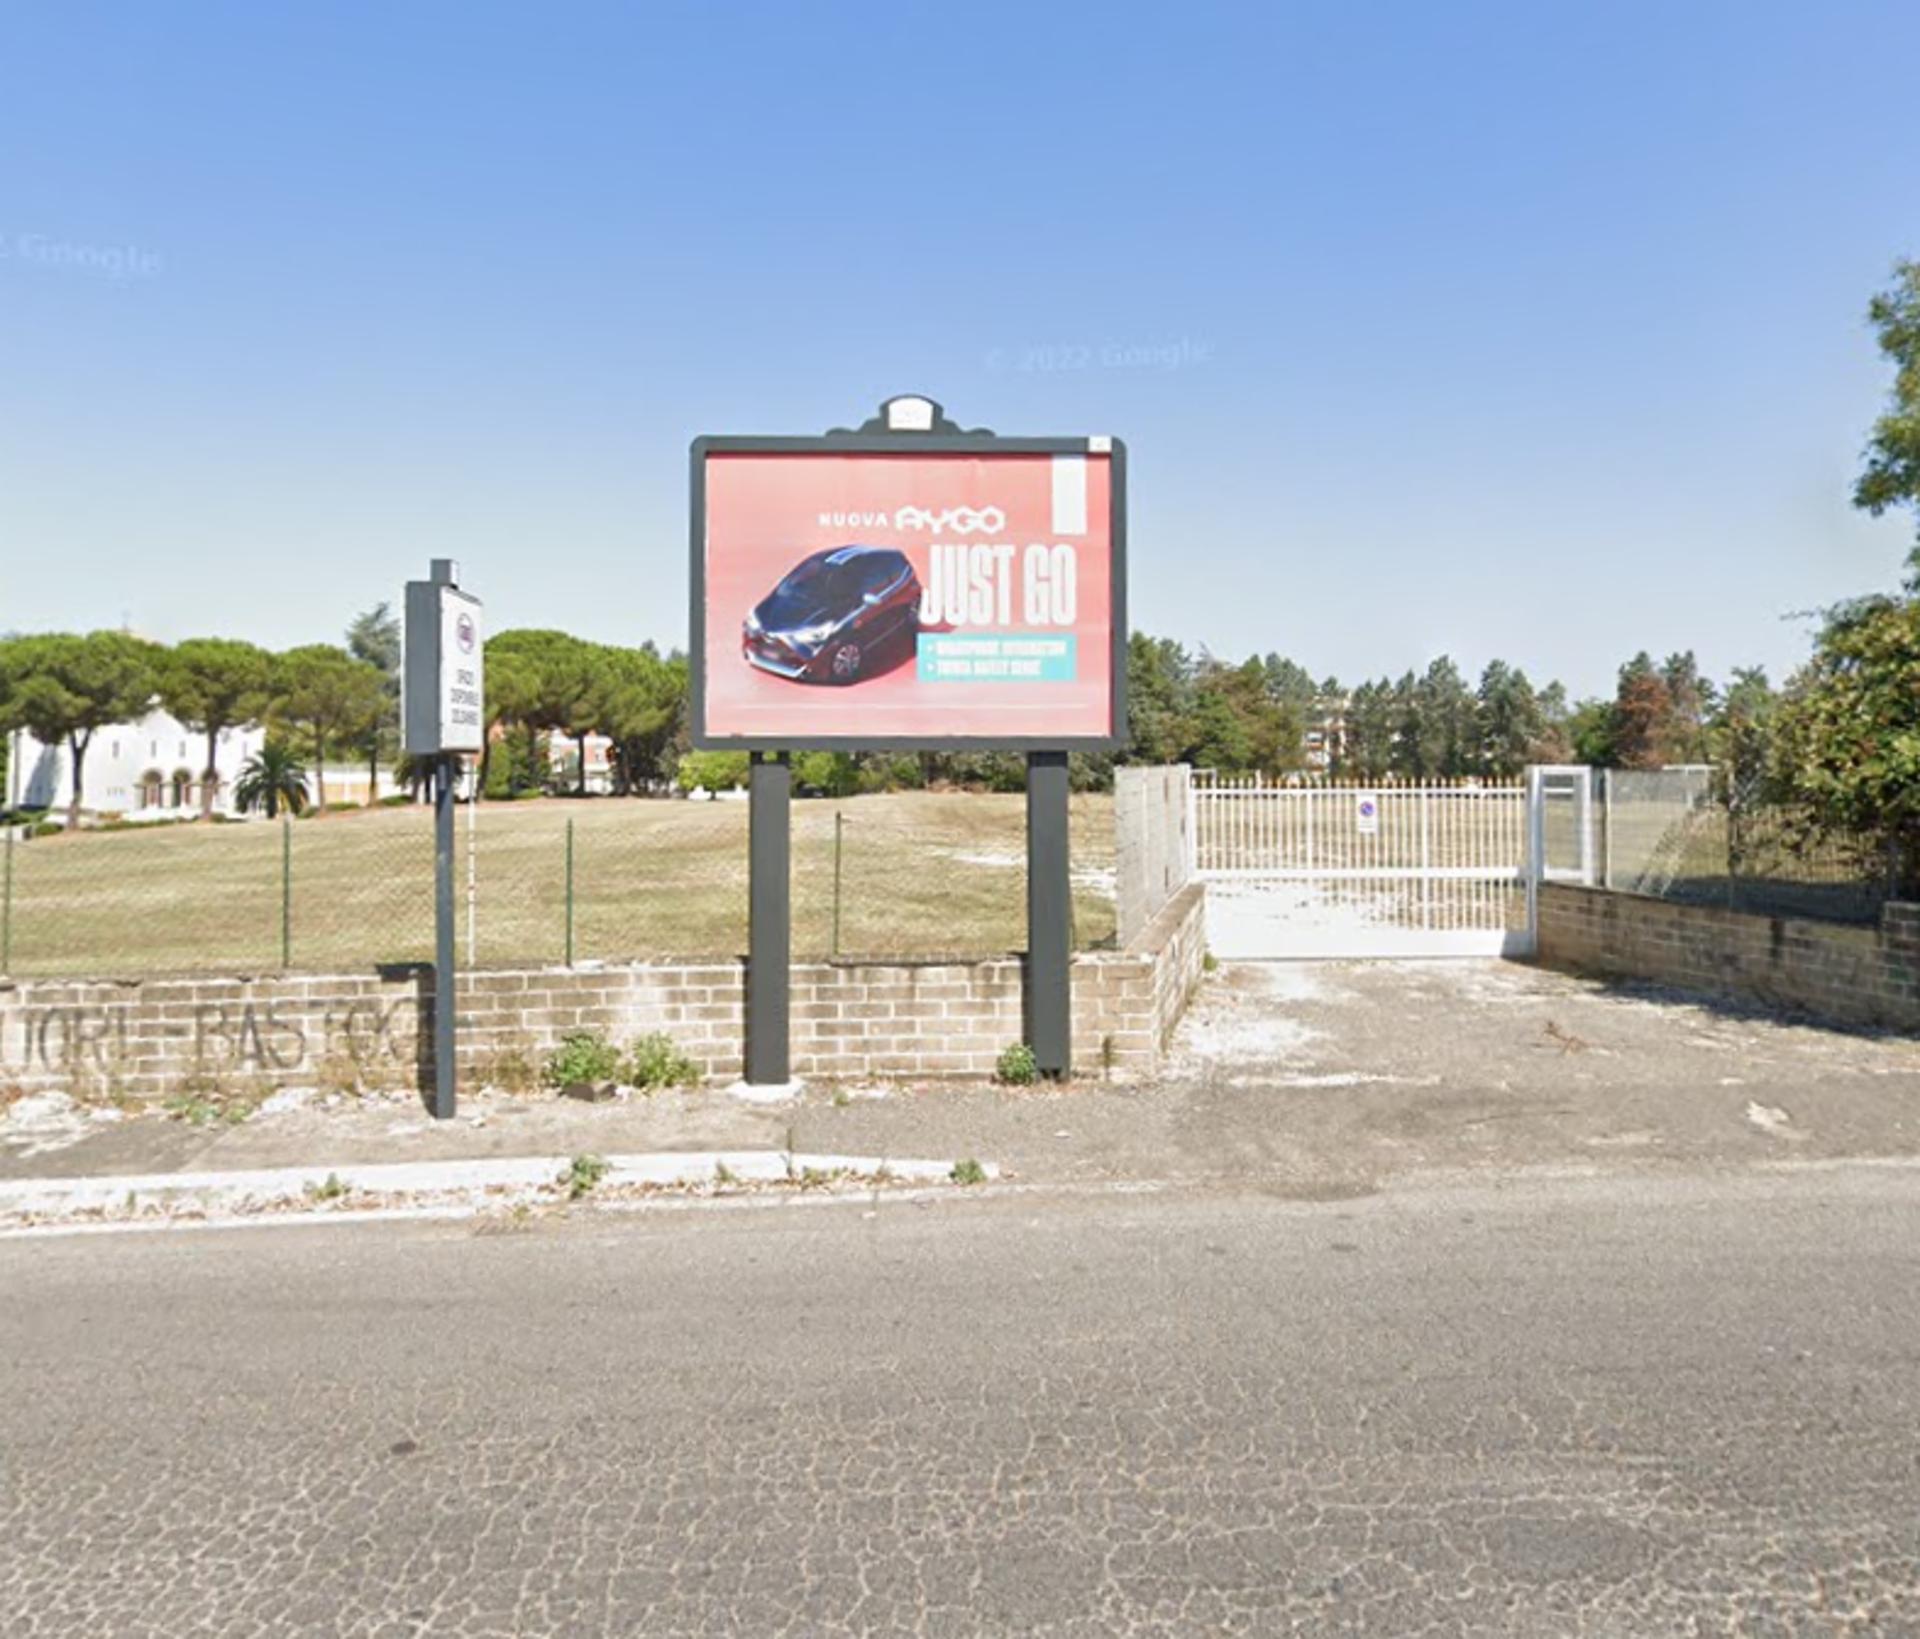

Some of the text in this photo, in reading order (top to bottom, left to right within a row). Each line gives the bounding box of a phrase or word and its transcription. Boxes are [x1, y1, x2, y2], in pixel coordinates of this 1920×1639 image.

[818, 505, 1006, 534] NUOVA AYGO
[918, 544, 1077, 626] JUST GO
